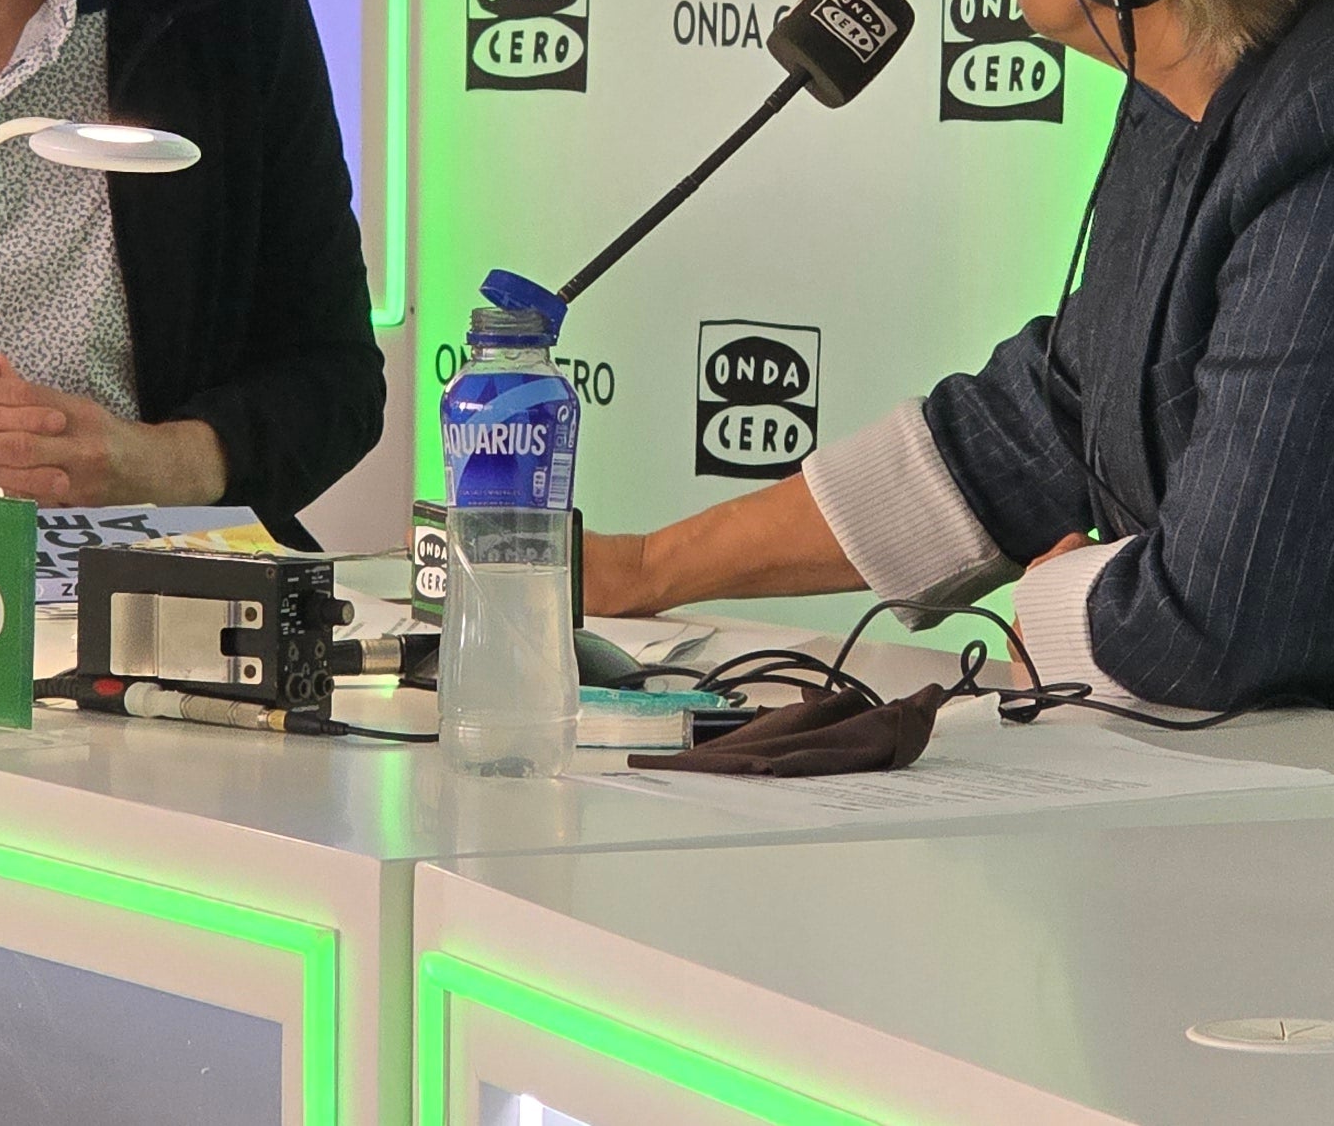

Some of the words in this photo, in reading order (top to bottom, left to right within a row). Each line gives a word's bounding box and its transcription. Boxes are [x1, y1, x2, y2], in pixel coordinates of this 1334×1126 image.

[674, 1, 762, 48] ONDA
[830, 11, 869, 46] CERO
[489, 31, 569, 63] CERO
[964, 56, 1045, 91] CERO
[715, 355, 799, 387] ONDA
[443, 423, 547, 458] AQUARIUS
[719, 415, 798, 453] CERO
[419, 540, 447, 561] ONDA
